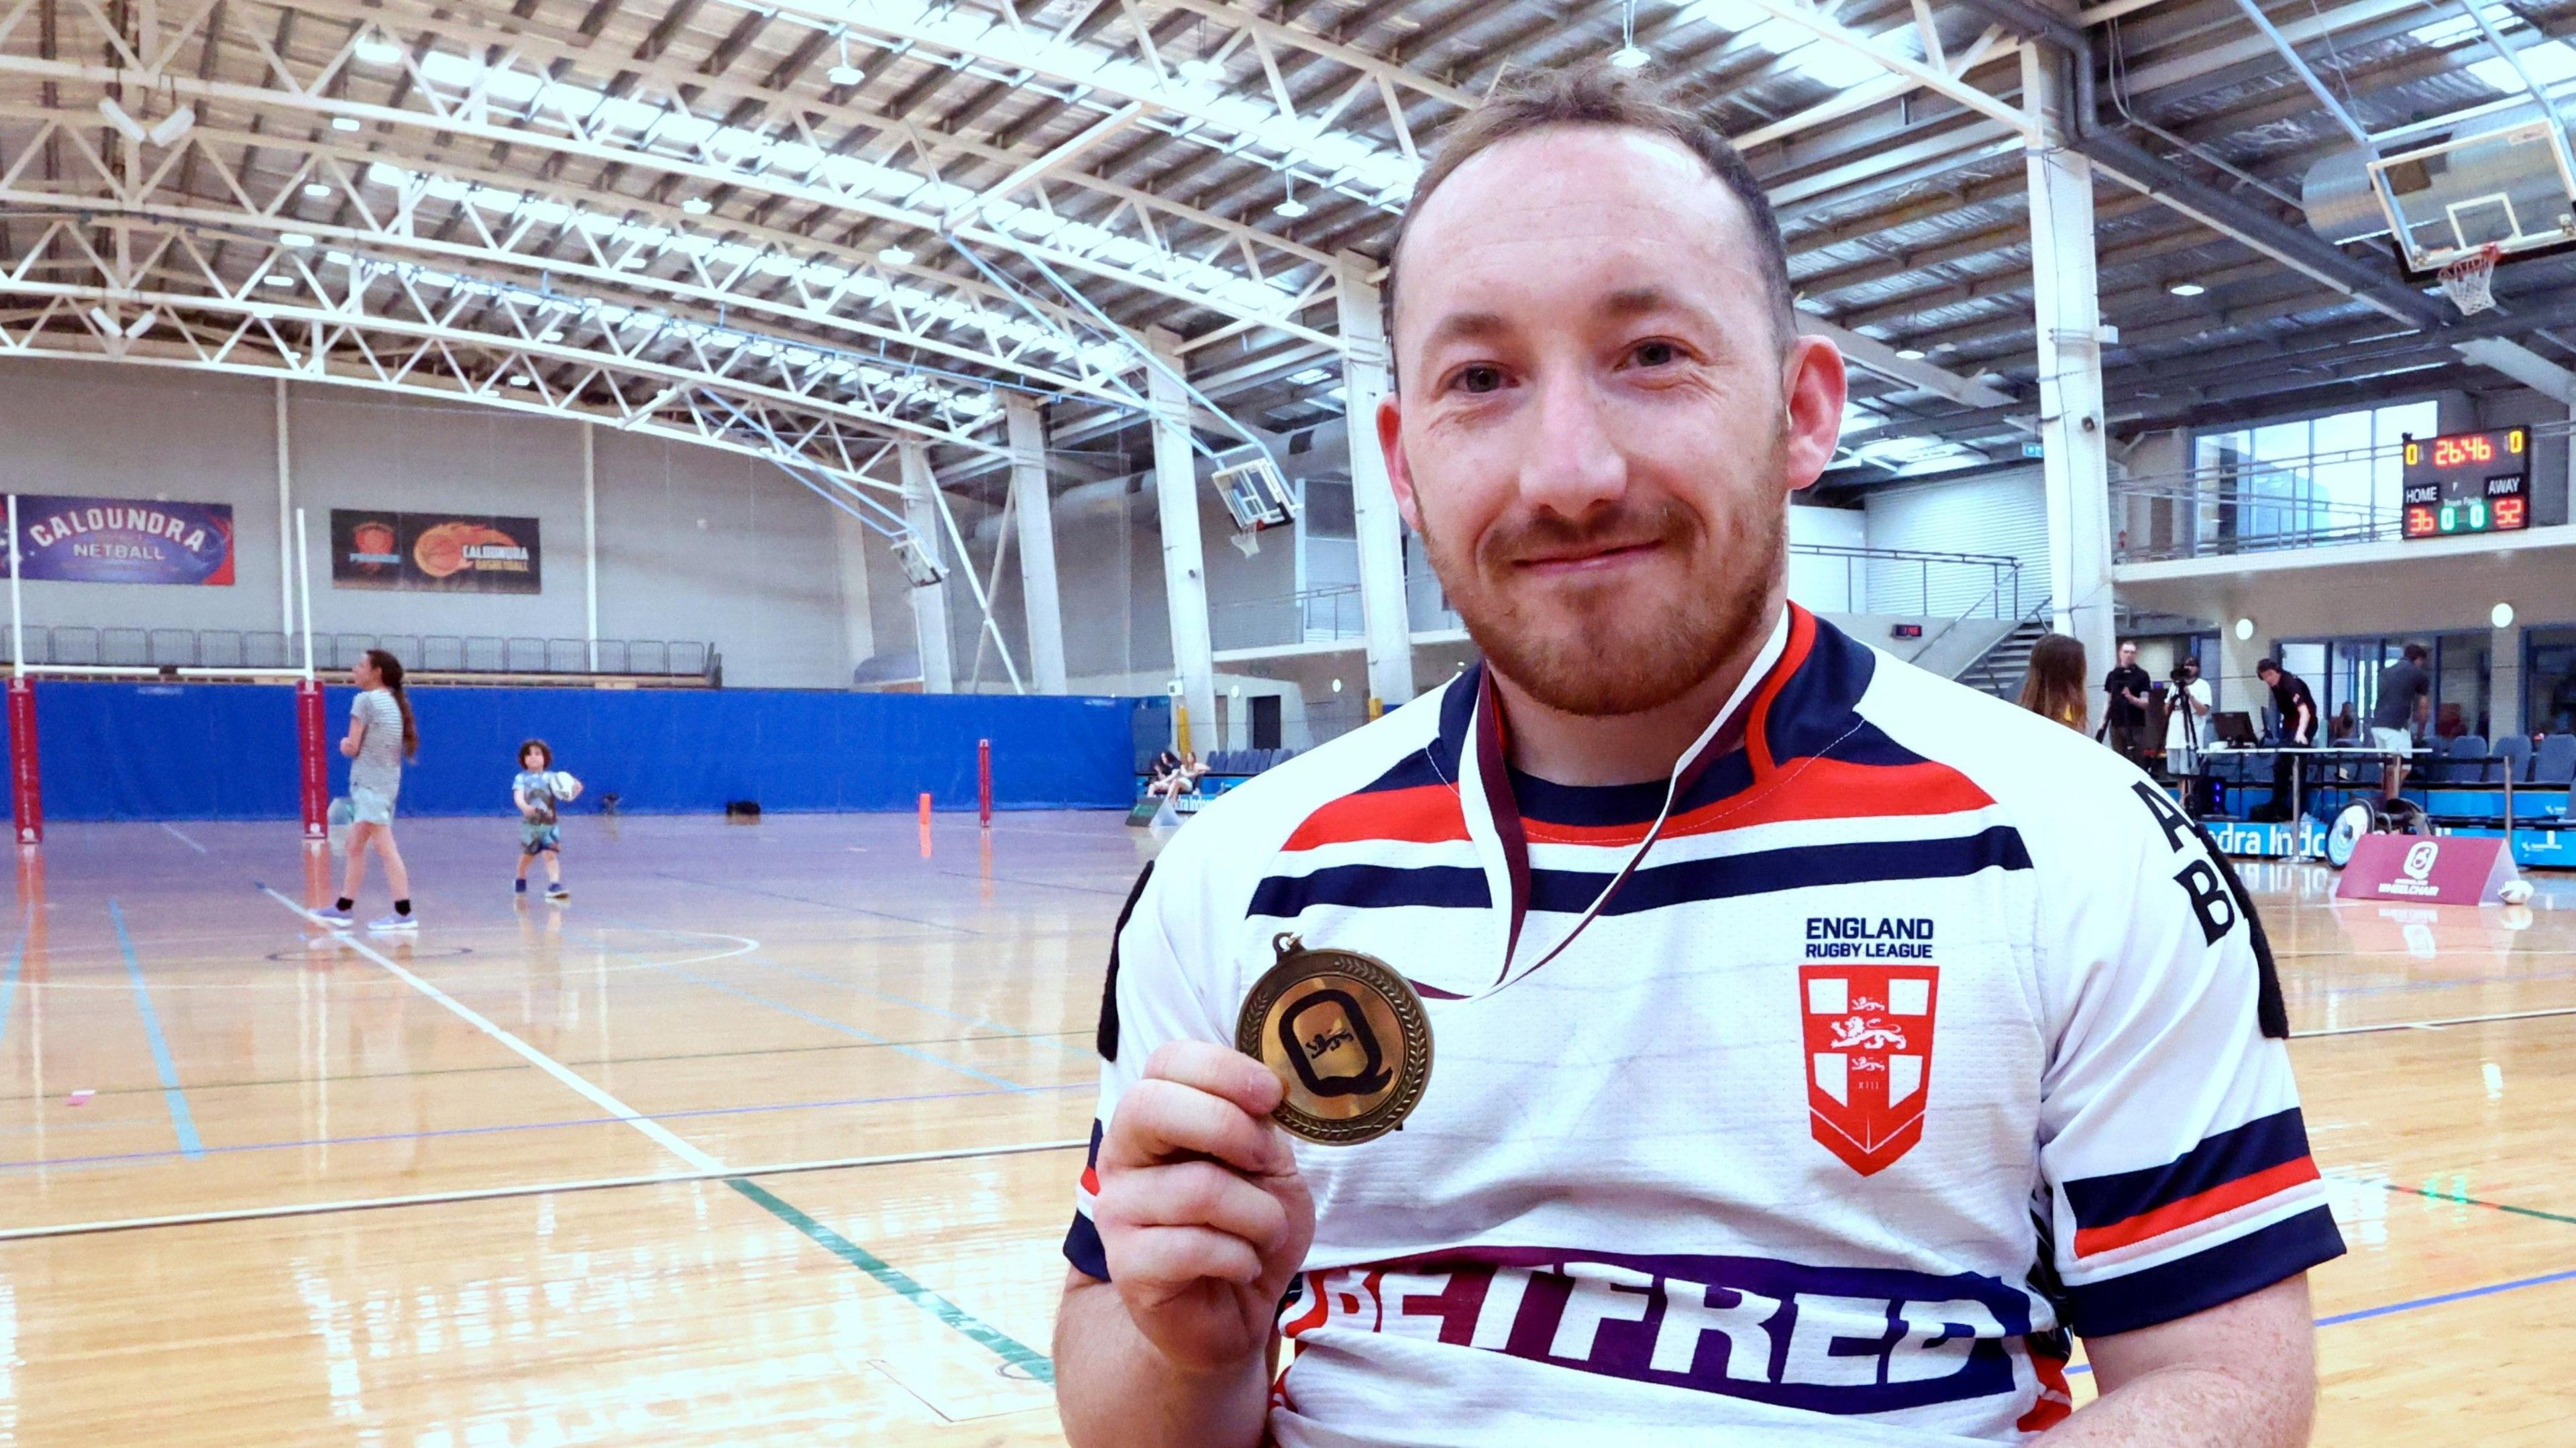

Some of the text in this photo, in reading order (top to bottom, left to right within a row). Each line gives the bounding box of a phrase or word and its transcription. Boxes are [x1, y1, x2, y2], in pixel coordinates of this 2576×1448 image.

[2509, 431, 2522, 453] 0
[2406, 443, 2418, 465] 0
[2406, 486, 2437, 503] HOME
[2488, 478, 2520, 495] AWAY
[2410, 508, 2434, 533] 36
[2440, 507, 2455, 531] 0
[2470, 504, 2484, 528] 0
[2496, 500, 2522, 525] 52
[30, 508, 205, 552] CALOUNDRA
[73, 543, 166, 560] NETBALL
[1806, 917, 1934, 940] ENGLAND
[1806, 943, 1933, 958] RUGBY LEAGUE
[1323, 1262, 2006, 1386] BETFRED
